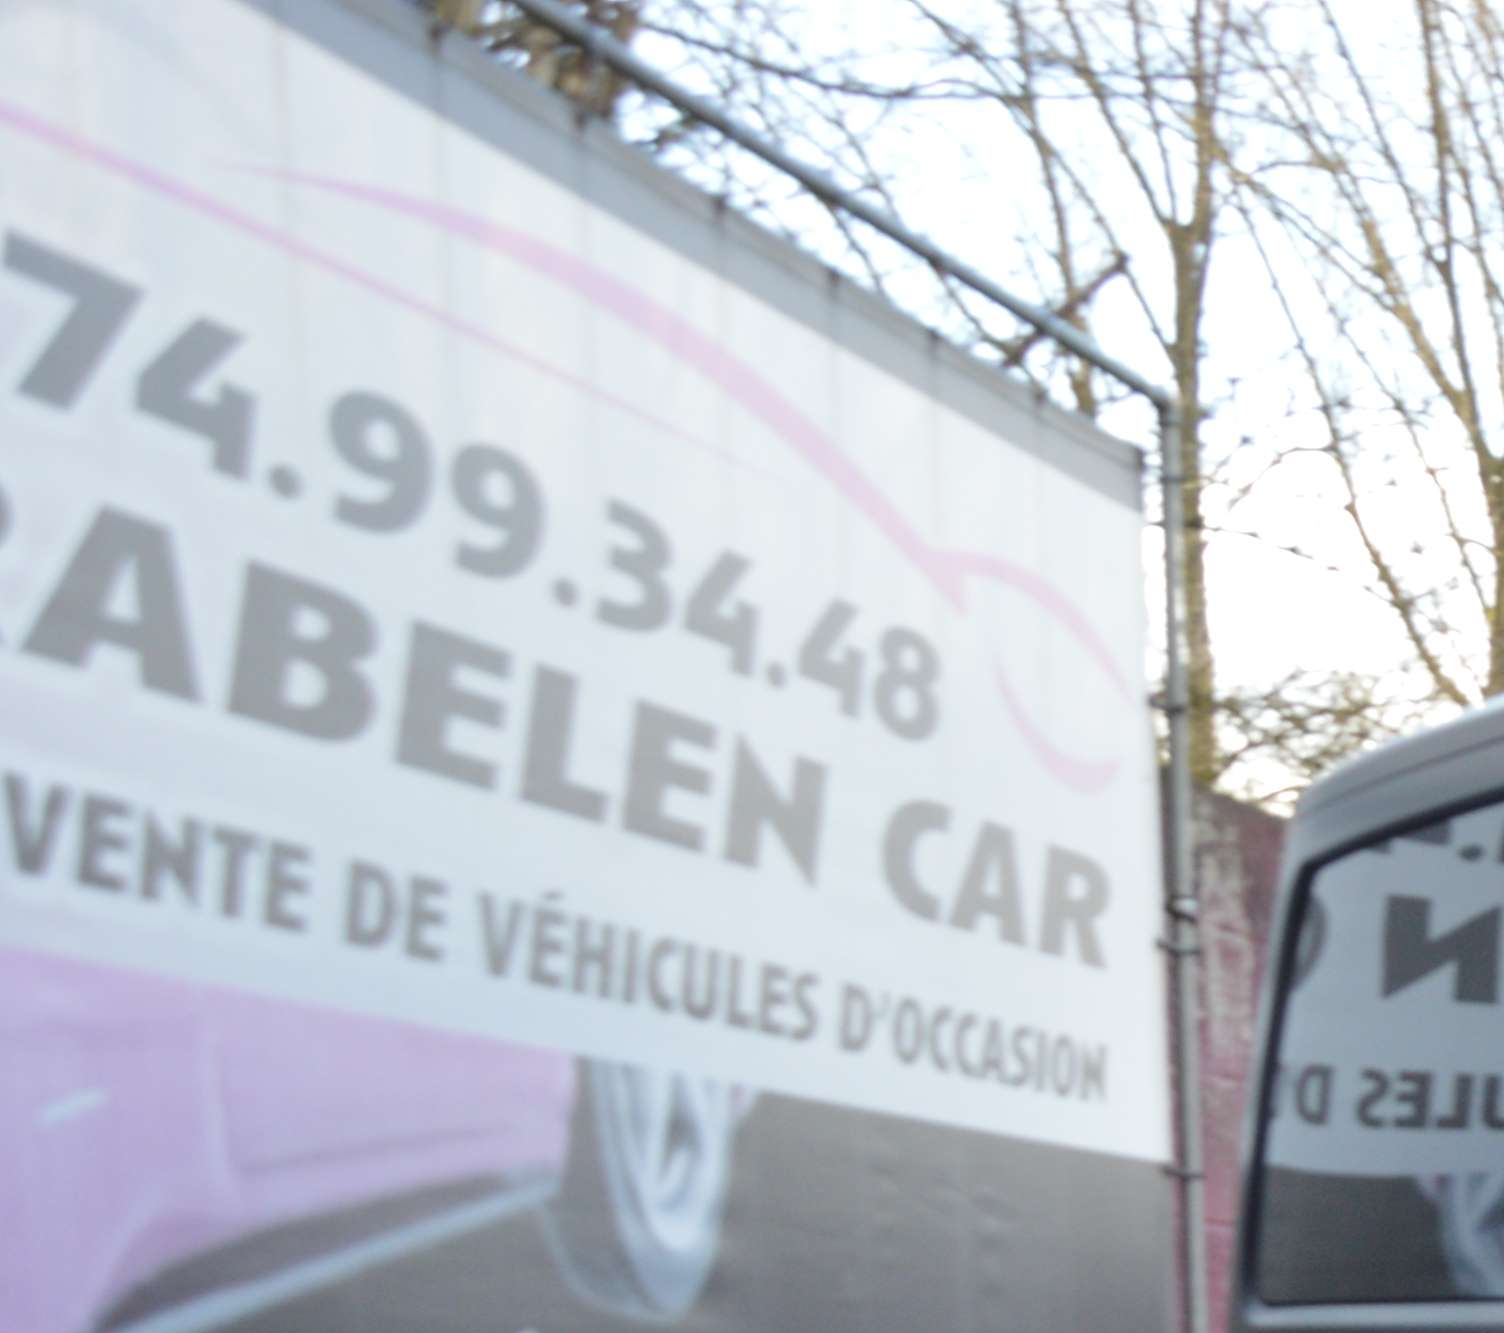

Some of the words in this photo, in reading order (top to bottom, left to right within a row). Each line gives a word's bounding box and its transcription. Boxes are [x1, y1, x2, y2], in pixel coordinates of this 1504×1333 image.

[0, 480, 832, 888] ABELEN
[879, 798, 1115, 970] CAR
[2, 769, 311, 935] VENTE
[343, 857, 449, 967] DE
[475, 889, 821, 1043] VÉHICULES
[837, 982, 1107, 1103] D'OCCASION
